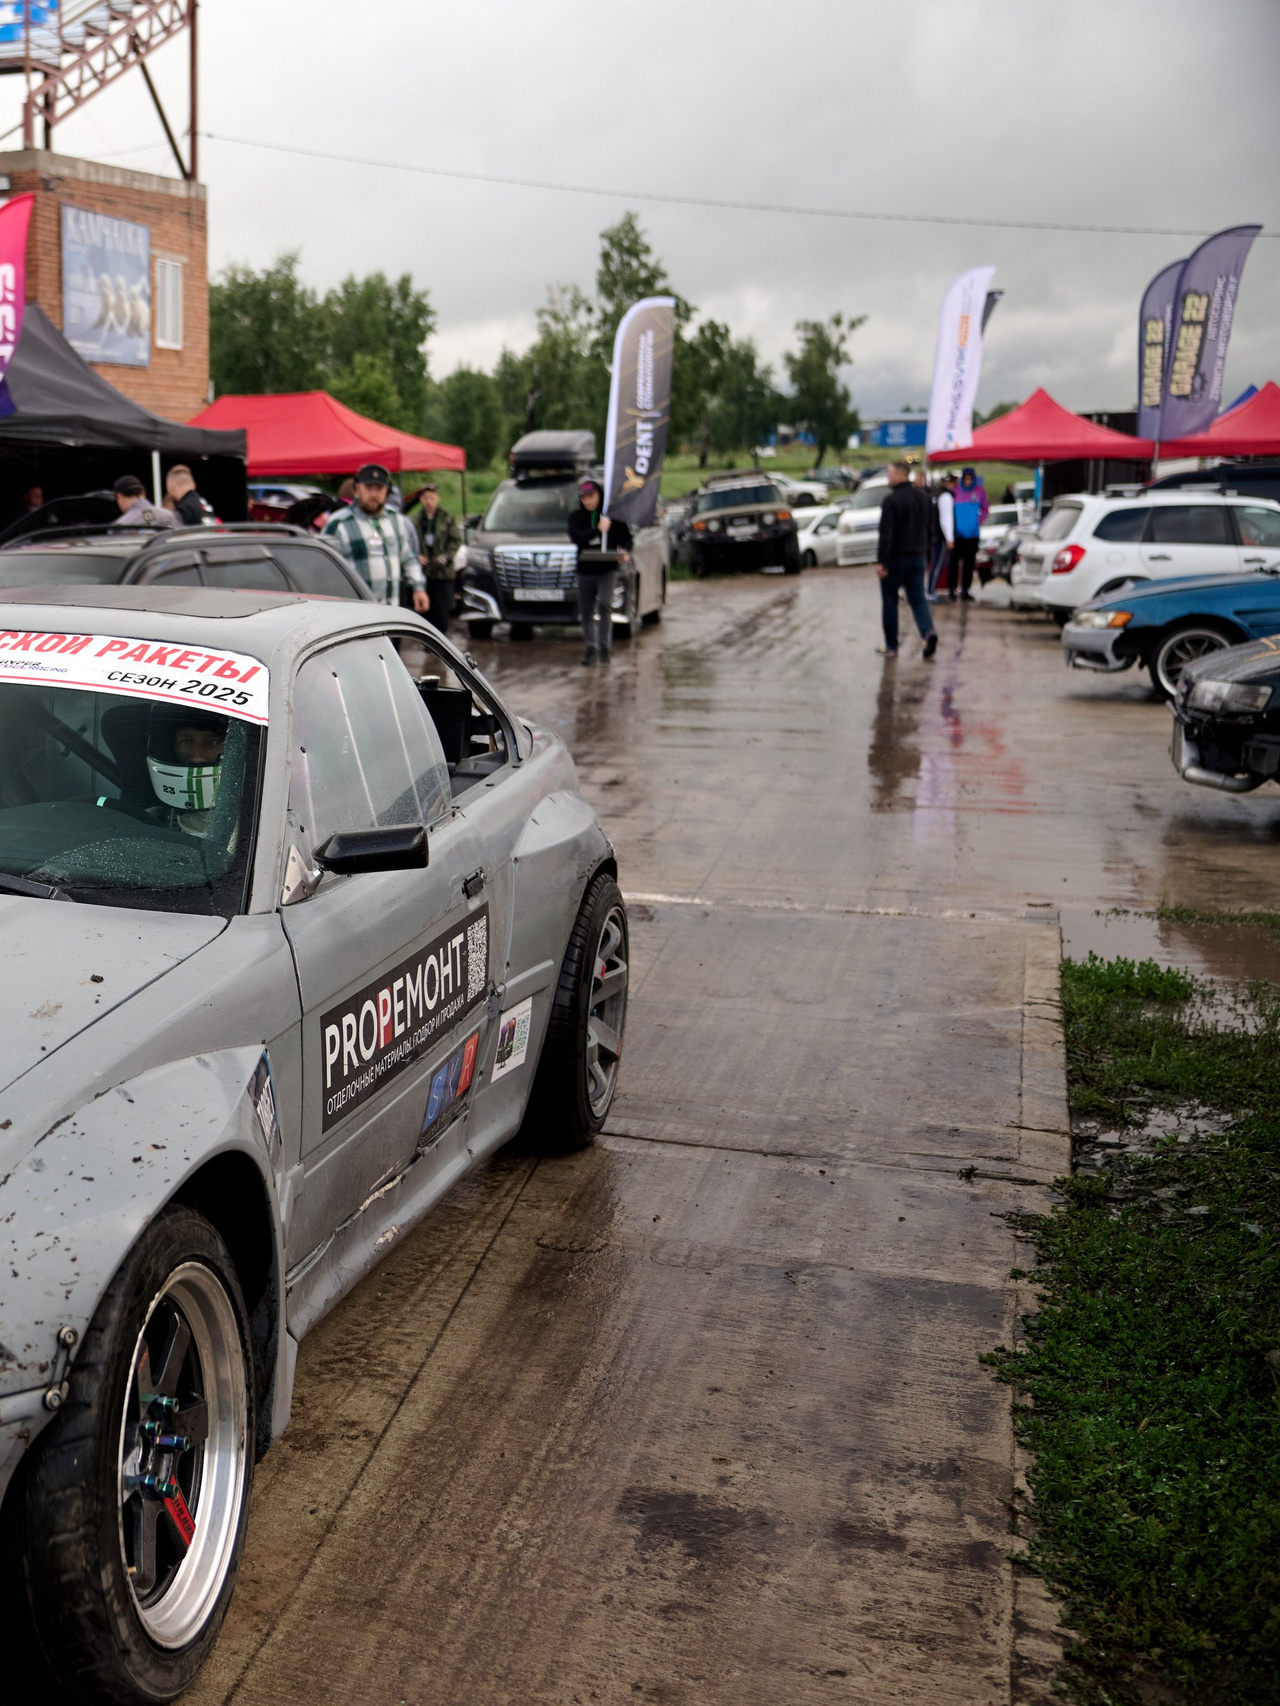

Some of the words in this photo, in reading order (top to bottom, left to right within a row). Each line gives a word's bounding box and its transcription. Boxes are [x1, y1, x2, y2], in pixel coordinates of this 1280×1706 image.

[635, 420, 654, 474] DENT
[95, 640, 261, 683] РАКЕТЫ
[106, 670, 178, 690] СЕЗОН
[179, 679, 254, 706] 2025
[162, 784, 176, 795] 23
[326, 1062, 374, 1115] ОТДЕЛОЧНЫЕ
[440, 993, 465, 1023] ПРОДАЖА
